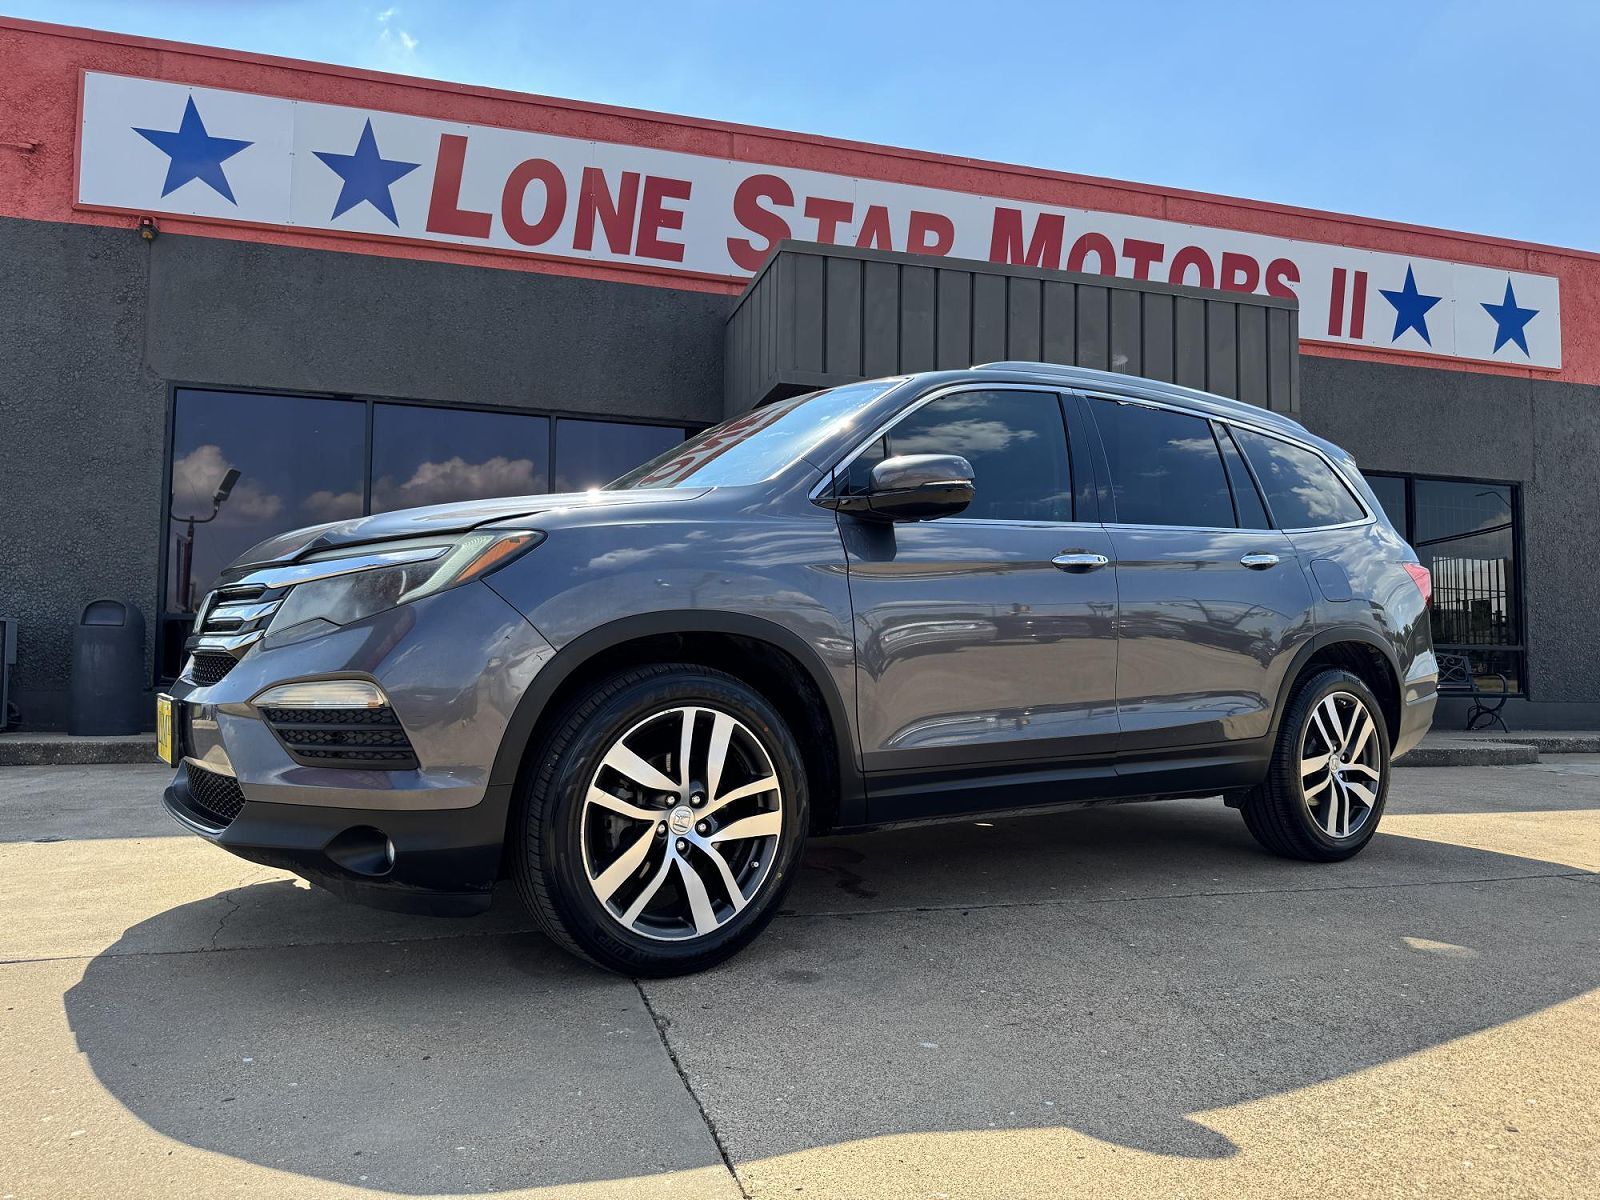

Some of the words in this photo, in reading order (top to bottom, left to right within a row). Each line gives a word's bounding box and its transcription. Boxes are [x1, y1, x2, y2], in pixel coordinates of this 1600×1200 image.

[427, 134, 692, 263] LONE
[726, 173, 956, 273] STAR
[988, 206, 1301, 299] MOTORS
[1327, 267, 1368, 340] II
